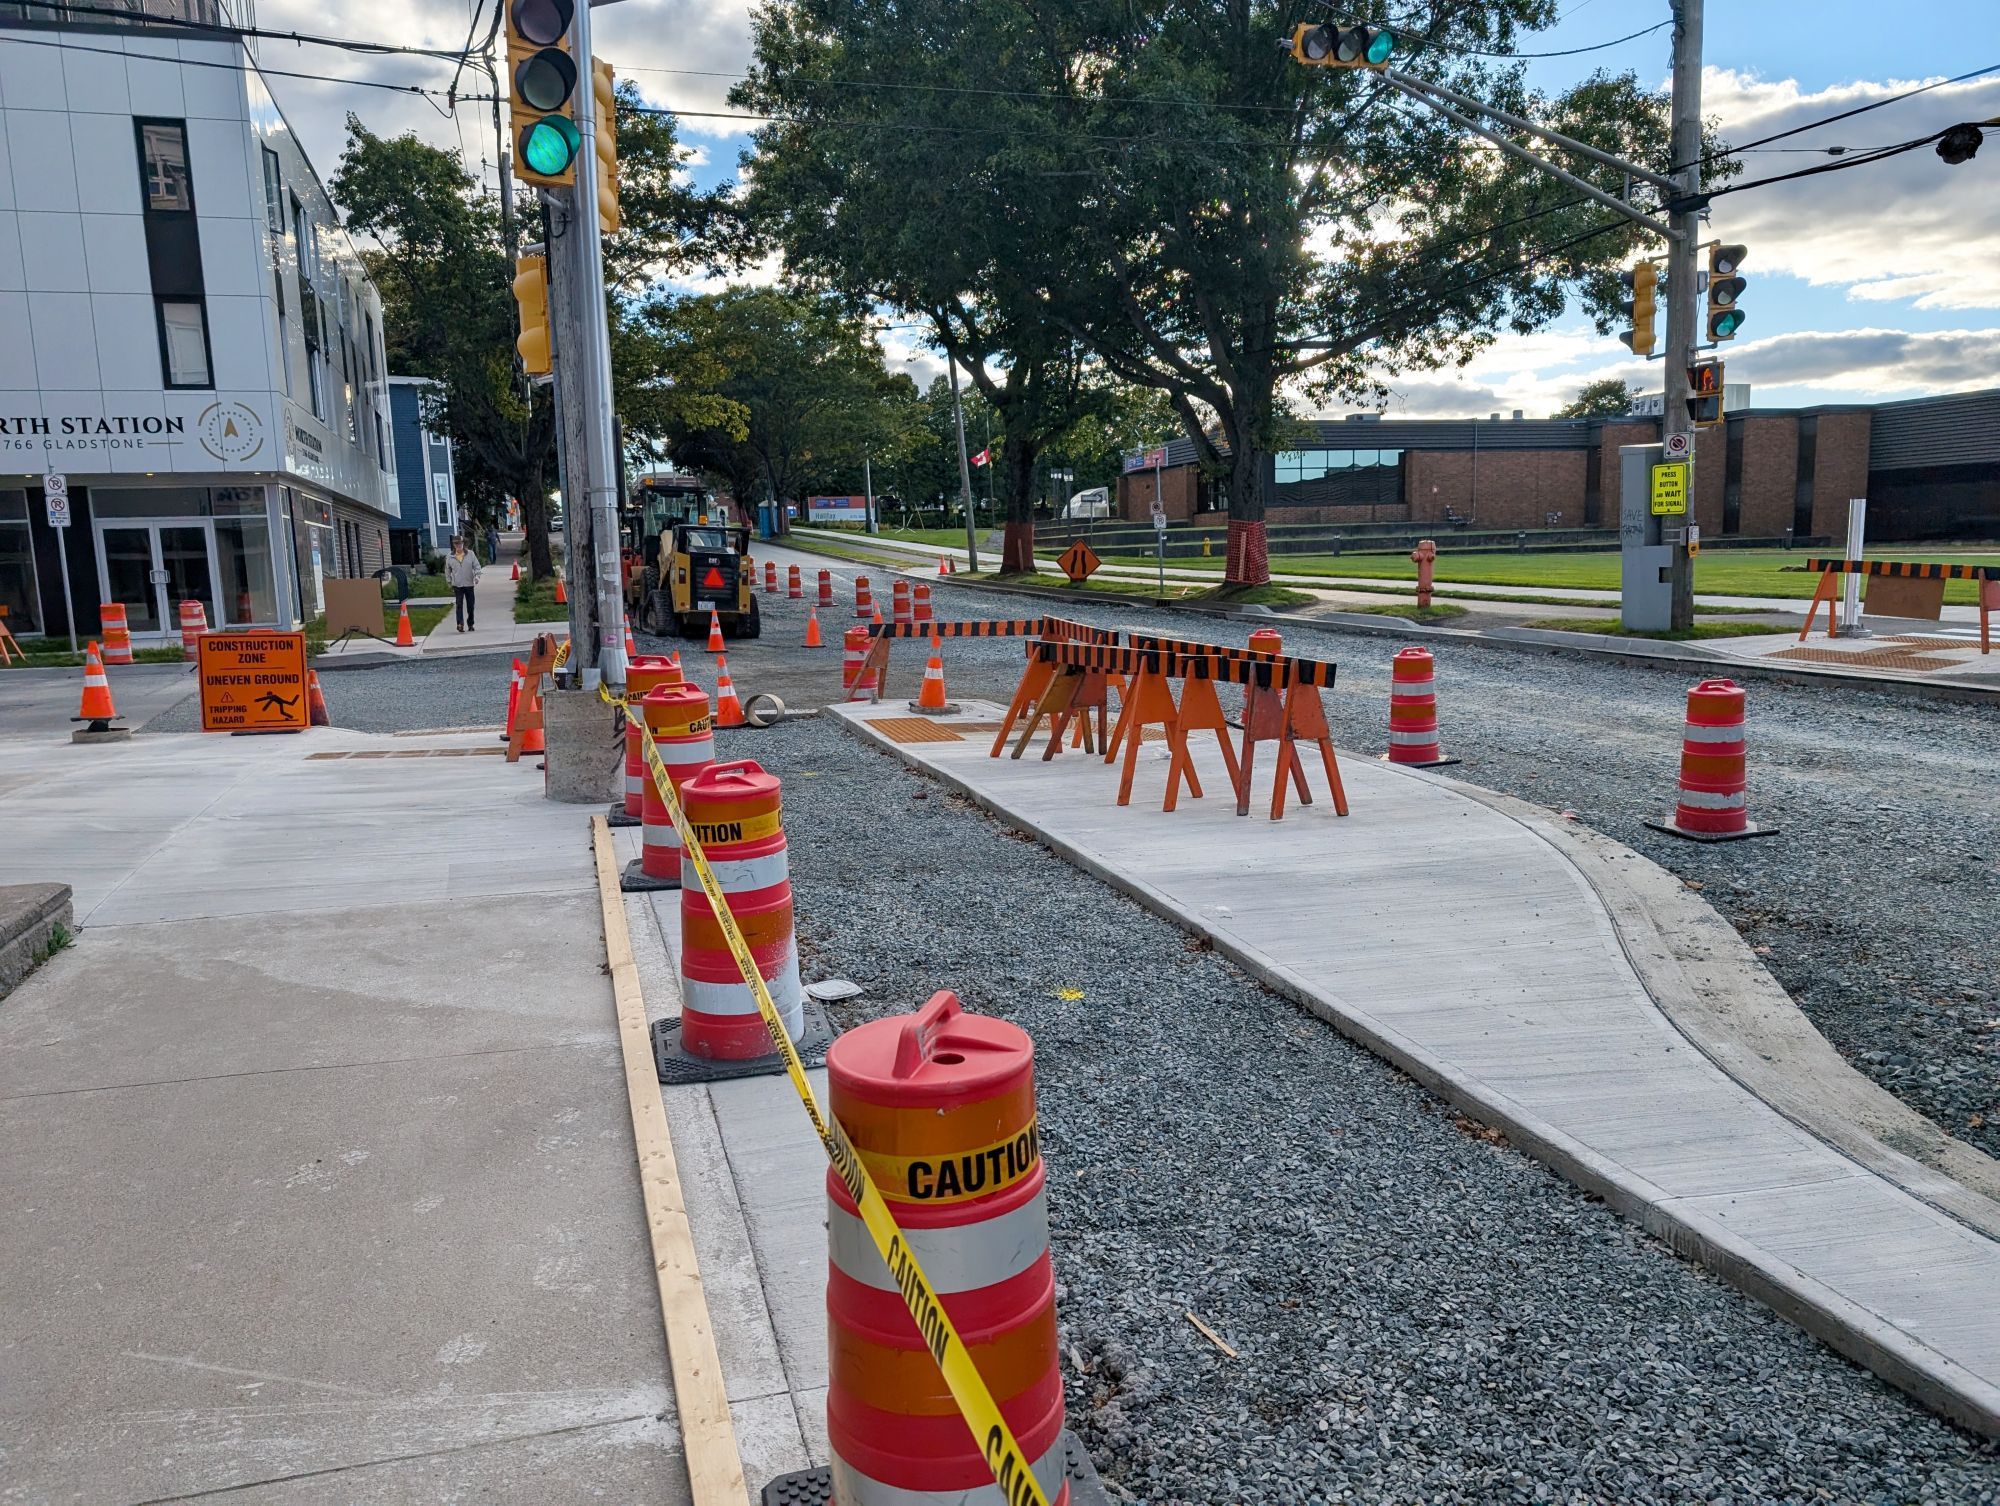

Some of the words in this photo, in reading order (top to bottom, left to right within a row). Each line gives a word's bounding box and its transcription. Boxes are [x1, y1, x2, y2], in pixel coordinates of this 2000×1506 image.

[0, 417, 51, 434] RTH
[61, 416, 184, 434] STATION
[4, 439, 33, 449] 766
[43, 439, 144, 449] GLADSTONE
[1664, 490, 1682, 498] WAIT
[209, 640, 293, 652] CONSTRUCTION
[238, 653, 266, 664] ZONE
[206, 675, 251, 686] UNEVEN
[254, 674, 300, 685] GROUND
[209, 705, 247, 714] TRIPPING
[212, 716, 245, 724] HAZARD
[907, 1119, 1039, 1199] CAUTION
[886, 1234, 950, 1369] CAUTION
